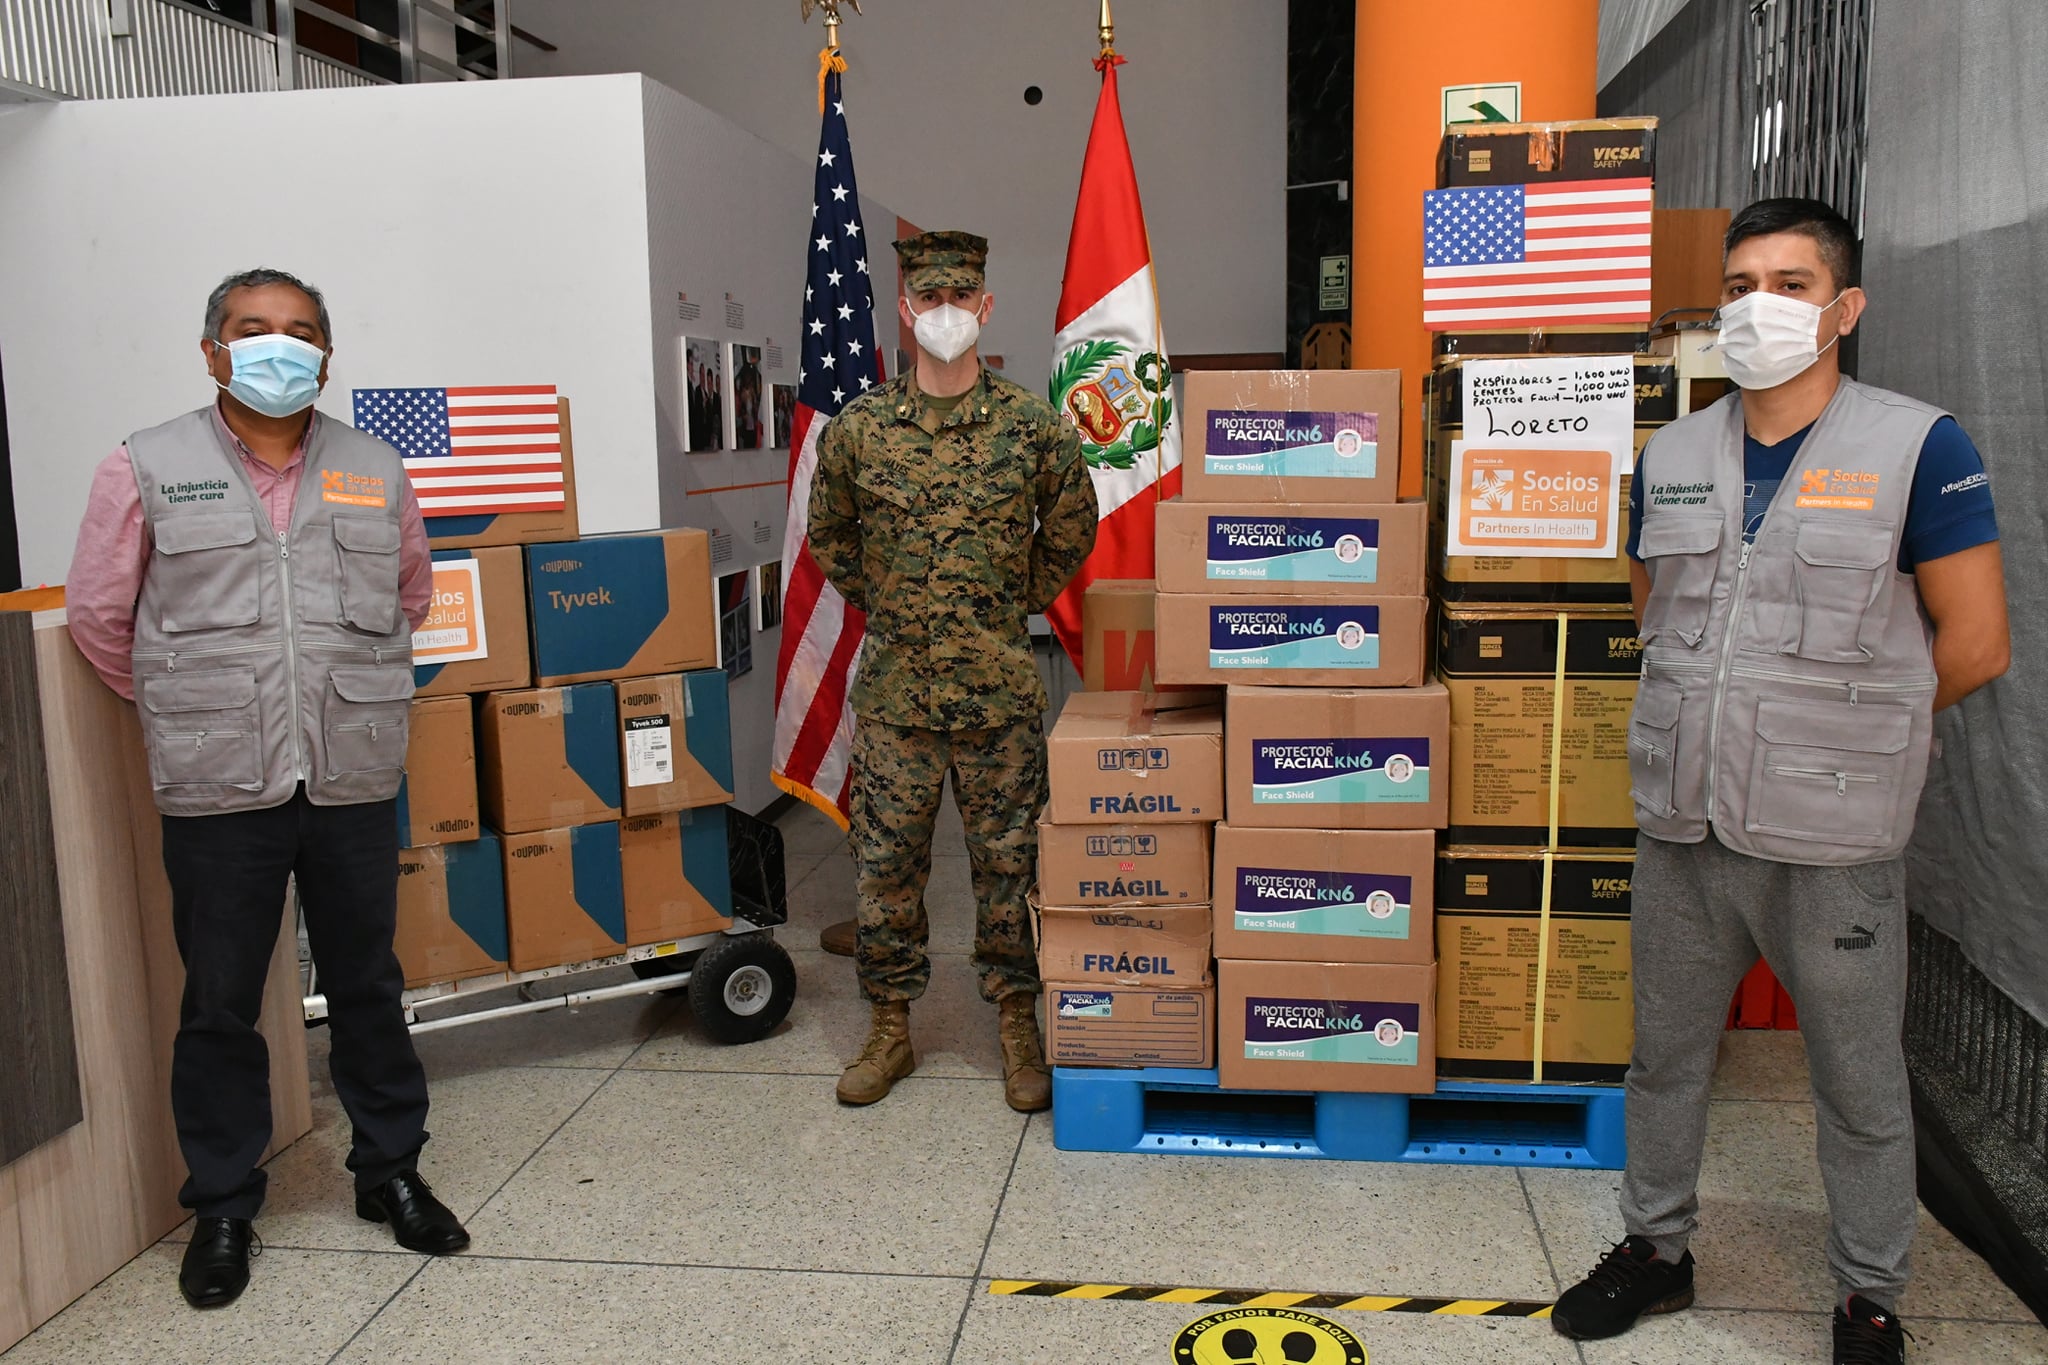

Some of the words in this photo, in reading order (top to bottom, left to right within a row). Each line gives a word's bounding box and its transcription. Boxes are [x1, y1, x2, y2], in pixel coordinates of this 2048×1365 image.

[1593, 147, 1641, 160] VICSA
[1593, 160, 1622, 168] SAFETY
[1215, 418, 1285, 430] PROTECTOR
[1486, 406, 1589, 437] LORETO
[1227, 429, 1284, 441] FACIAL
[1213, 462, 1234, 471] Face
[1236, 462, 1264, 472] Shield
[1522, 470, 1599, 492] Socios
[1832, 469, 1879, 483] Socios
[161, 485, 175, 495] La
[177, 480, 229, 494] injusticia
[1651, 484, 1664, 495] La
[1665, 482, 1714, 496] injusticia
[169, 492, 197, 504] tiene
[199, 491, 224, 501] cura
[1522, 495, 1543, 512] En
[1548, 496, 1598, 512] Salud
[1654, 495, 1681, 505] tiene
[1682, 495, 1707, 505] cura
[1216, 523, 1286, 535] PROTECTOR
[1477, 522, 1530, 534] Partners
[1534, 523, 1545, 534] In
[1549, 524, 1589, 536] Health
[1229, 535, 1285, 547] FACIAL
[546, 560, 578, 573] DUPONT
[1215, 567, 1236, 576] Face
[1238, 567, 1266, 576] Shield
[429, 589, 465, 608] cios
[548, 587, 612, 613] Tyvek
[1218, 613, 1288, 624] PROTECTOR
[1230, 624, 1287, 635] FACIAL
[427, 633, 462, 645] Health
[1608, 637, 1643, 650] VICS
[1218, 656, 1239, 665] Face
[1241, 656, 1269, 665] Shield
[628, 694, 657, 706] DUPONT
[507, 703, 540, 716] DUPONT
[632, 720, 651, 728] Tyvek
[1261, 746, 1333, 758] PROTECTOR
[1275, 757, 1333, 769] FACIAL
[1262, 791, 1284, 800] Face
[1286, 791, 1314, 800] Shield
[1090, 792, 1181, 814] FRÁGIL
[435, 820, 470, 833] DUPONT
[627, 820, 658, 832] DUPONT
[516, 844, 549, 858] DUPONT
[399, 863, 421, 876] PONT
[1079, 877, 1169, 897] FRÁGIL
[1245, 875, 1316, 888] PROTECTOR
[1257, 887, 1315, 900] FACIAL
[1592, 891, 1621, 899] SAFETY
[1243, 919, 1265, 928] Face
[1267, 919, 1295, 929] Shield
[1834, 936, 1871, 950] PUMA
[1084, 952, 1175, 975] FRÁGIL
[1254, 1005, 1325, 1018] PROTECTOR
[1267, 1017, 1324, 1029] FACIAL
[1253, 1049, 1275, 1058] Face
[1277, 1049, 1305, 1058] Shield
[1187, 1320, 1215, 1337] POR
[1215, 1309, 1269, 1324] FAVOR
[1275, 1310, 1319, 1326] PARE
[1319, 1323, 1353, 1345] AQUI
